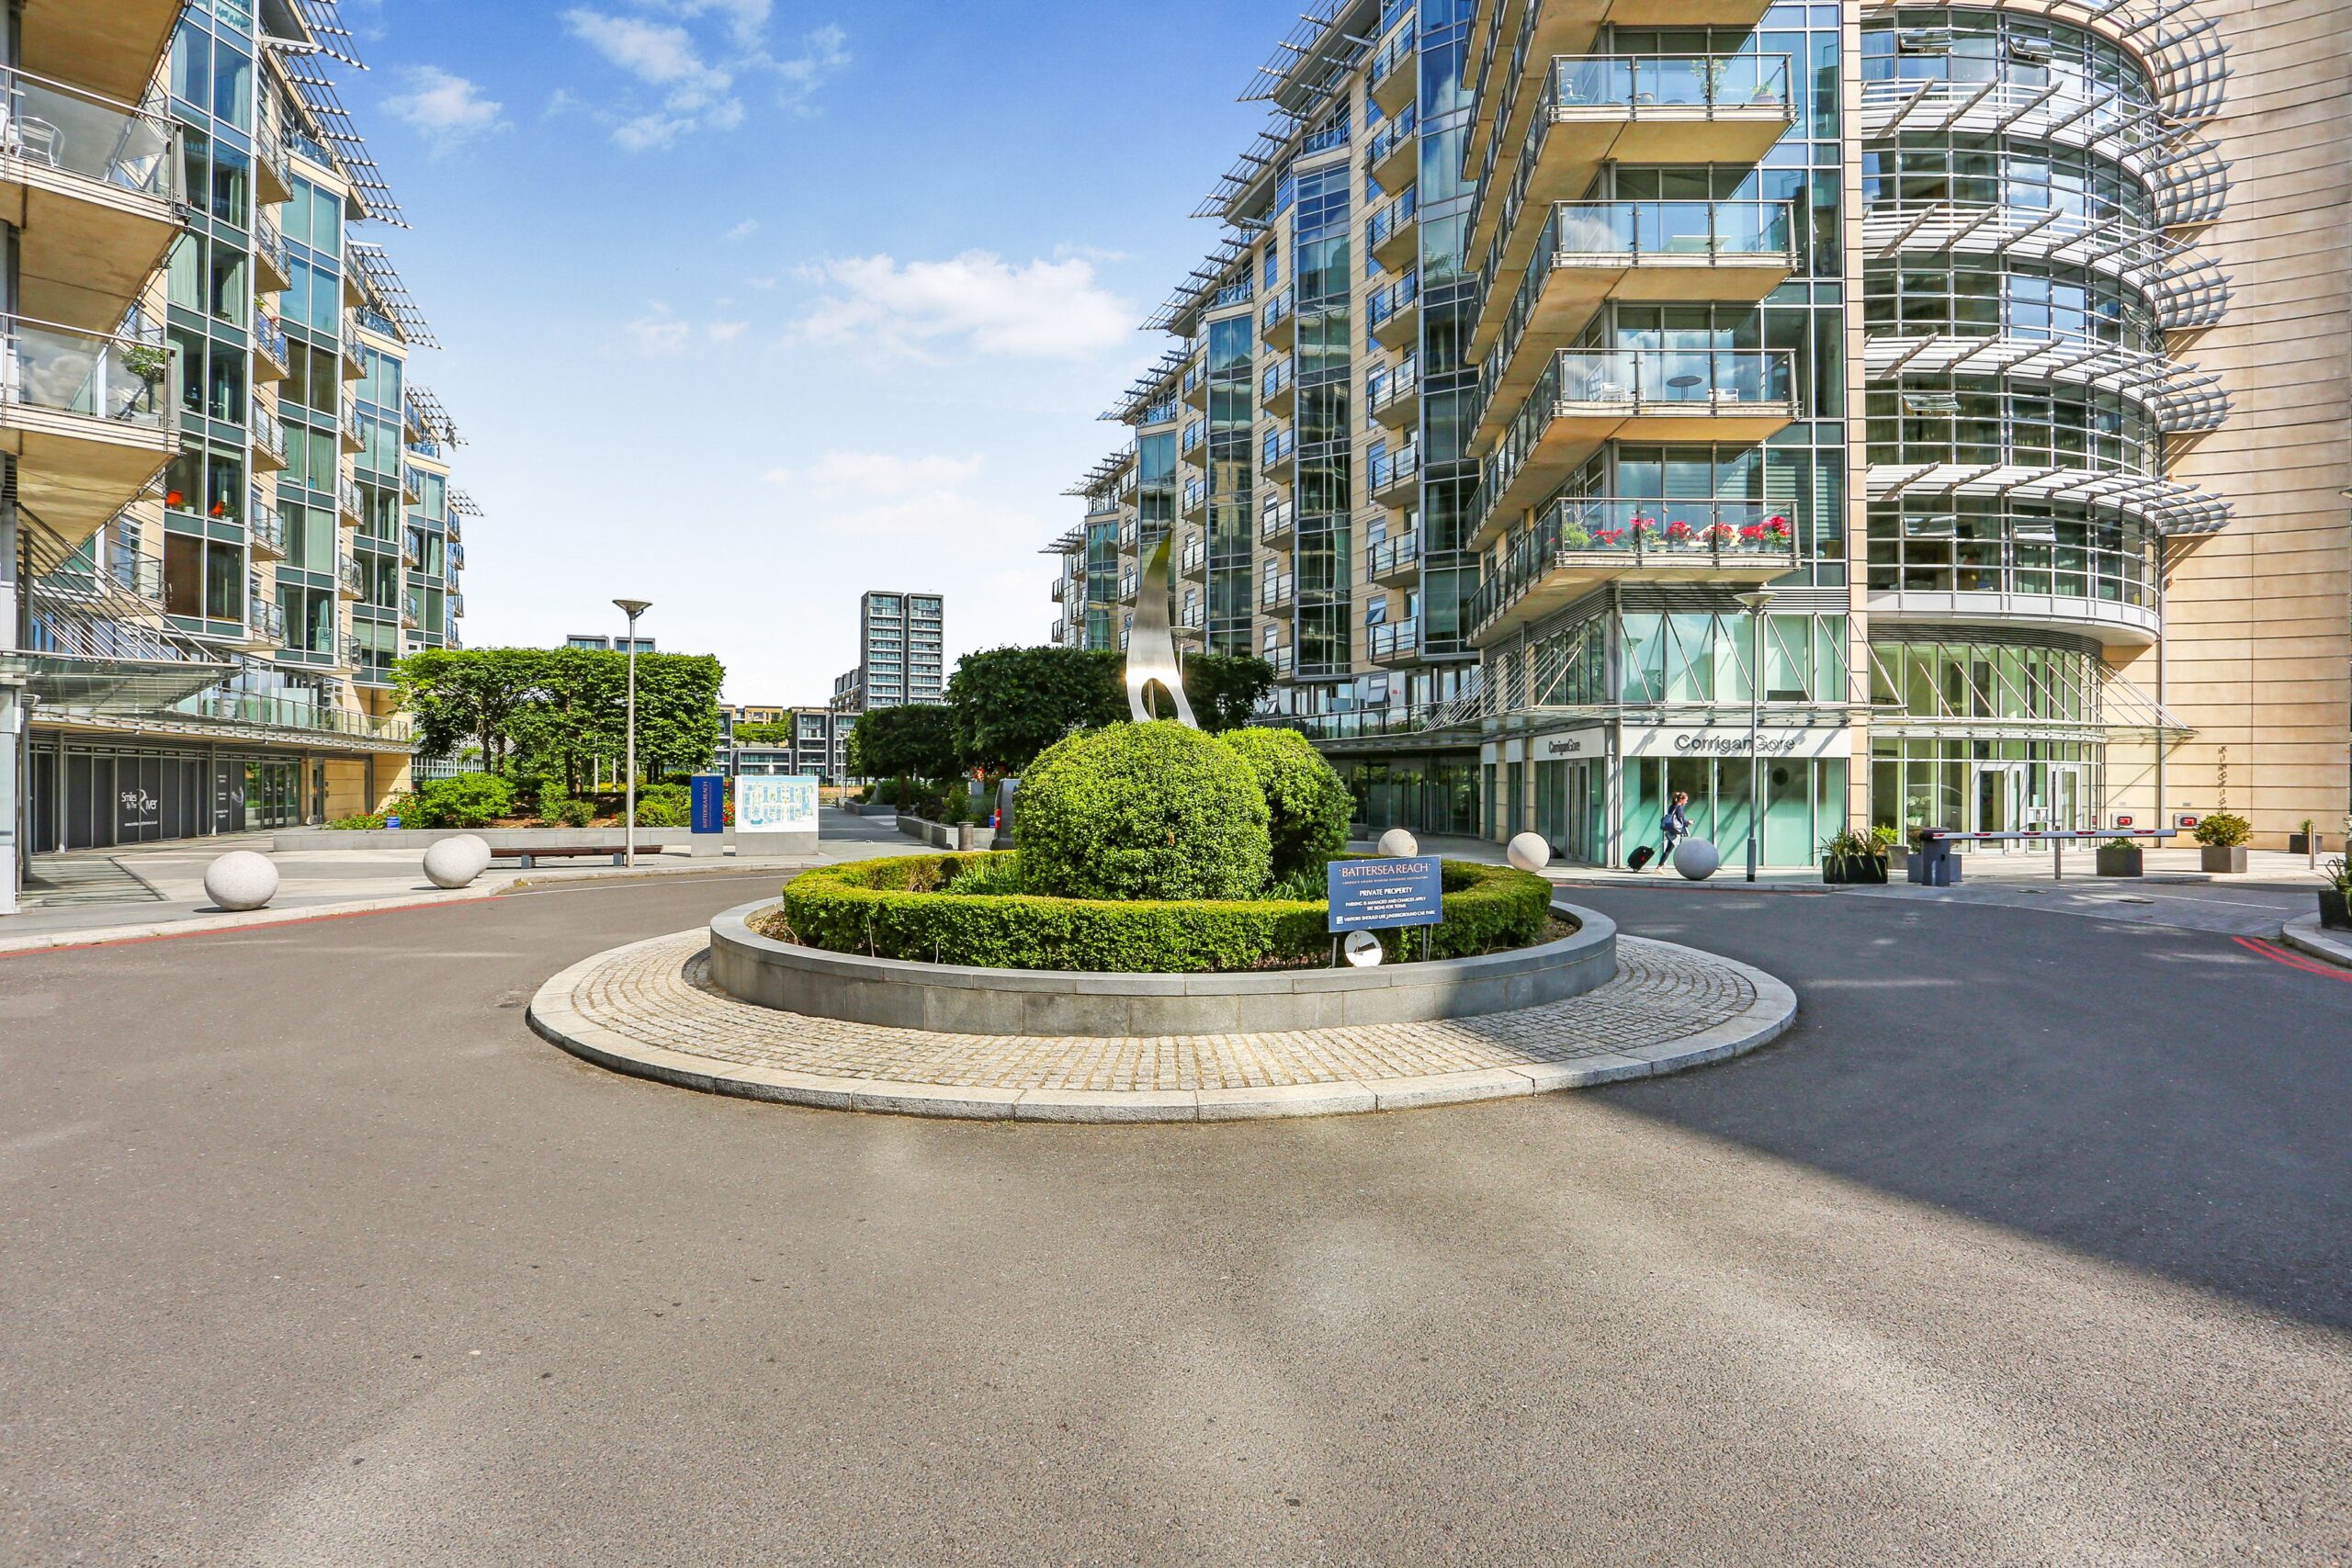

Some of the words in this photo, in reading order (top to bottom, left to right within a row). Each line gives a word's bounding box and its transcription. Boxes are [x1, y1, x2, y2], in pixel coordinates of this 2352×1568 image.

[1341, 865, 1395, 877] BATTERSEA
[1396, 863, 1428, 874] REACH
[1385, 886, 1413, 895] PROPERTY
